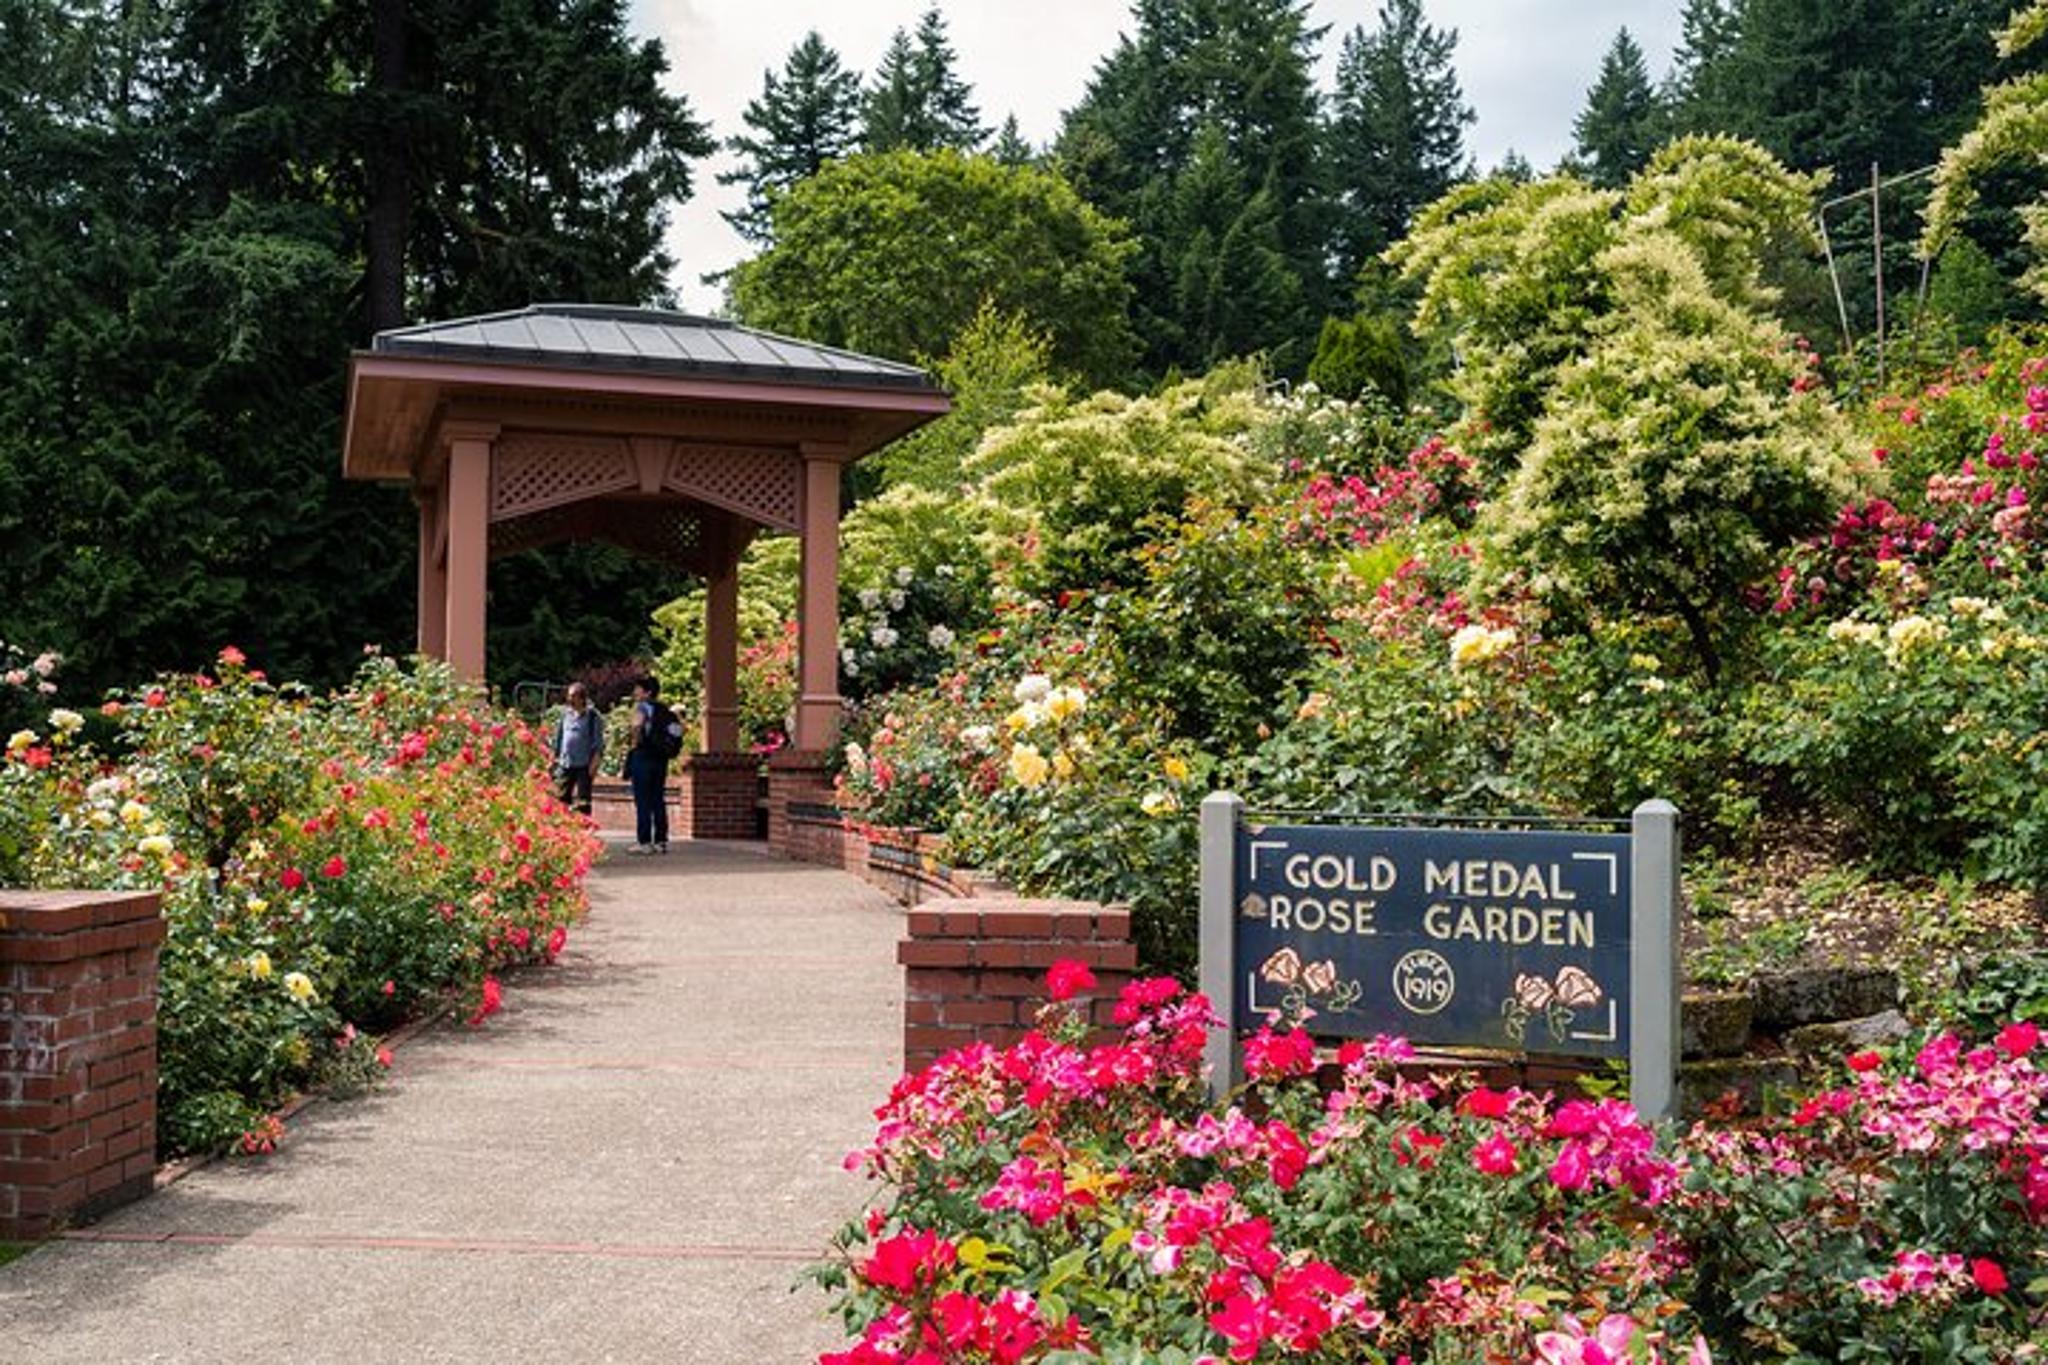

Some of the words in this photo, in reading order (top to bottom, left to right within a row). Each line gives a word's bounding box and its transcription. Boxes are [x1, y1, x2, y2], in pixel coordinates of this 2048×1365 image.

[1285, 854, 1397, 891] GOLD
[1425, 860, 1576, 900] MEDAL
[1270, 895, 1376, 935] ROSE
[1423, 909, 1595, 948] GARDEN
[1404, 977, 1448, 1001] 1919
